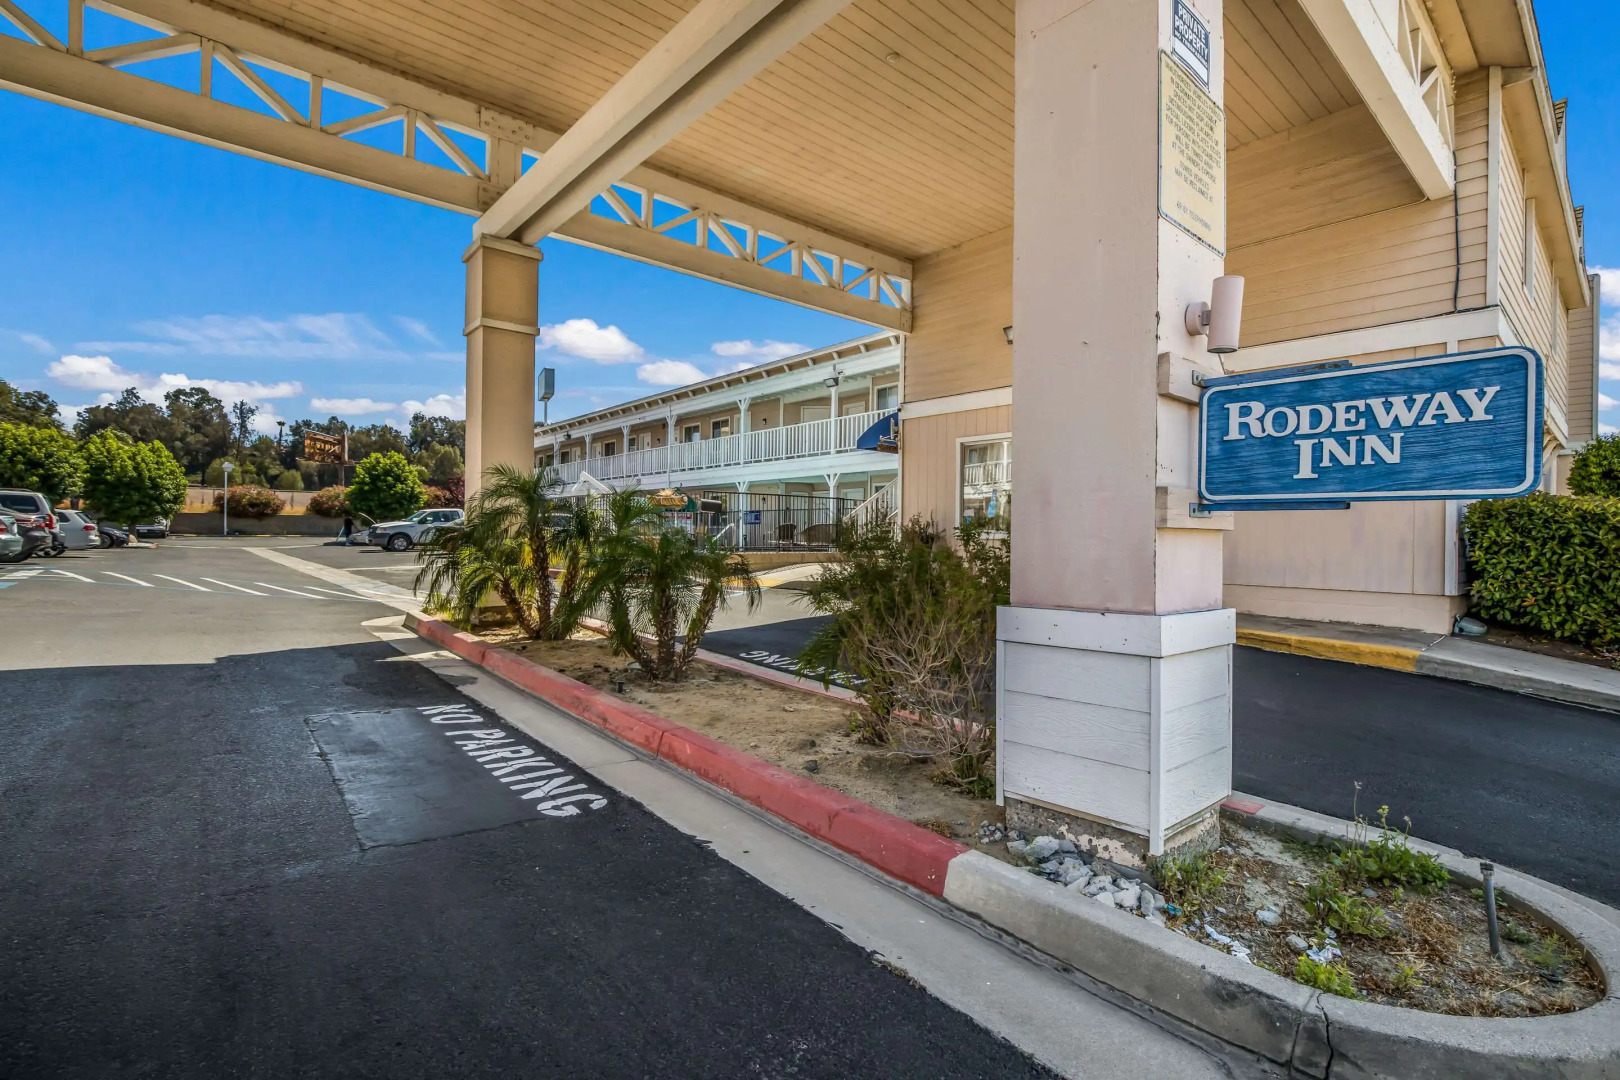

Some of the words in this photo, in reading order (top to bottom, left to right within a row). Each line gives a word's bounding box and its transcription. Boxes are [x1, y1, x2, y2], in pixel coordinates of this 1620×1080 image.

[1174, 13, 1209, 61] PROPERTY
[1178, 3, 1207, 45] PRIVATE
[1223, 385, 1501, 441] RODEWAY
[1293, 432, 1404, 479] INN
[416, 703, 484, 724] NO
[445, 728, 608, 817] PARKING
